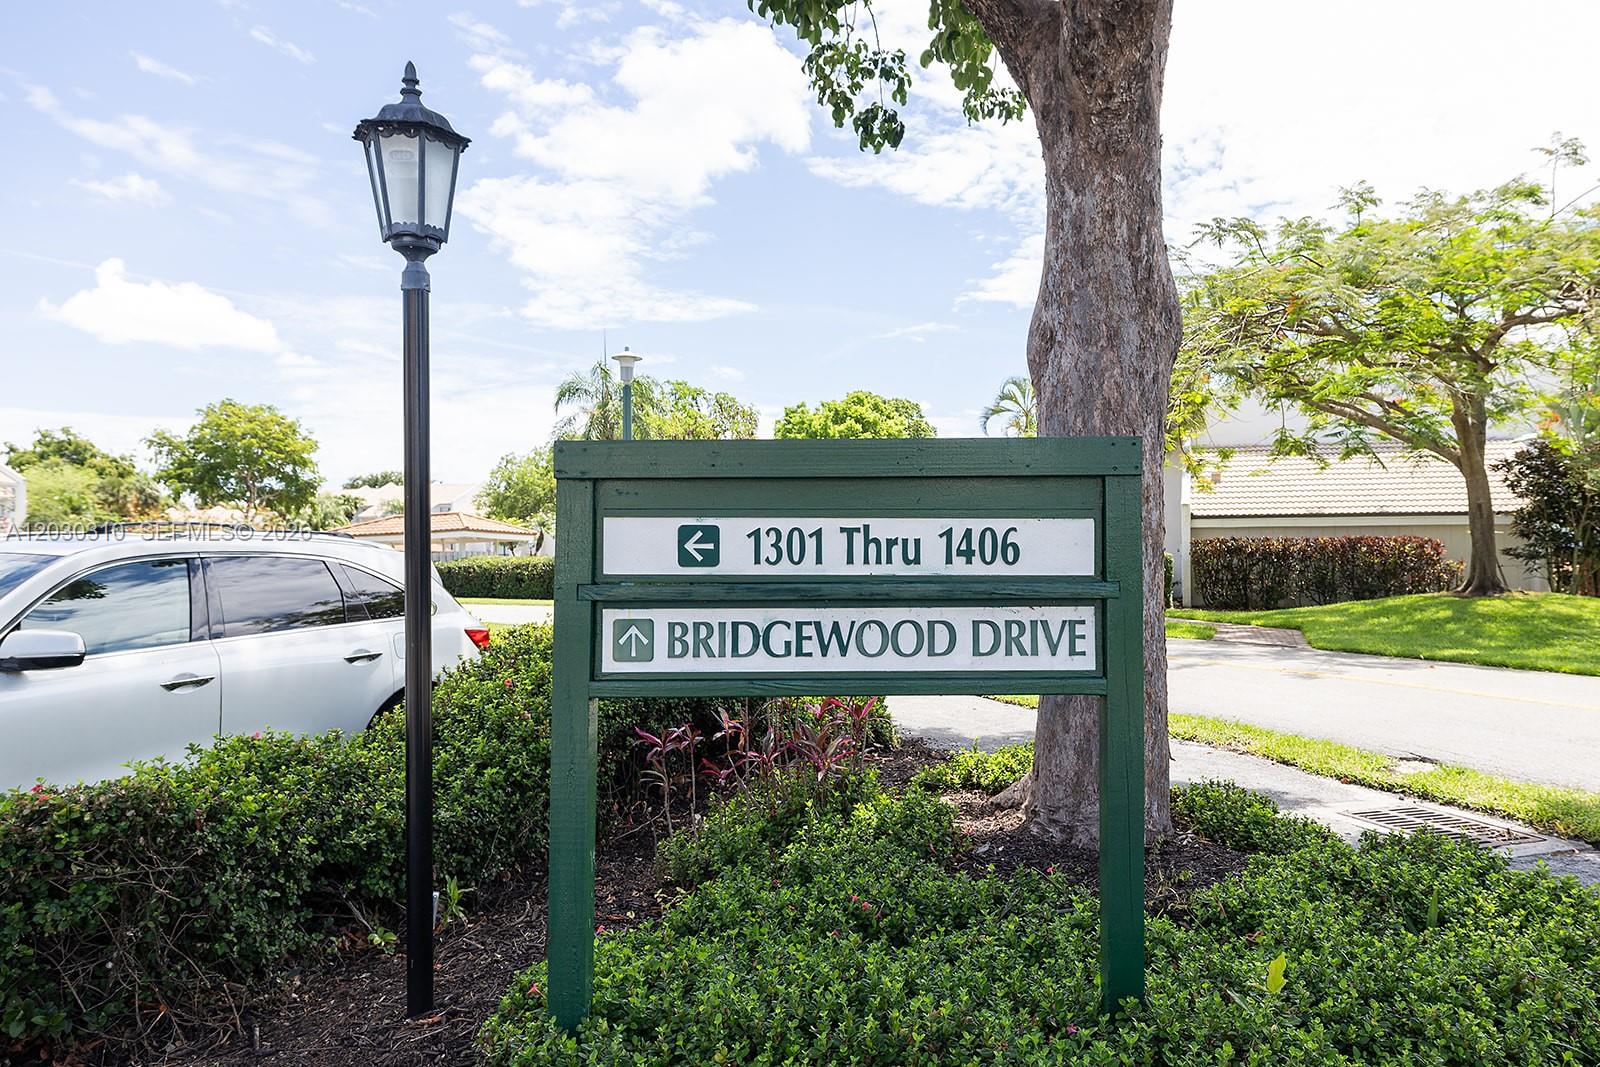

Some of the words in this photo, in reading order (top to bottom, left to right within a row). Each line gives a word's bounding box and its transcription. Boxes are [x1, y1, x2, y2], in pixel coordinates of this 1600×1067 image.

[745, 527, 823, 567] 1301
[839, 523, 922, 566] Thru
[937, 527, 1021, 567] 1406
[667, 619, 957, 659] BRIDGEWOOD
[971, 619, 1087, 657] DRIVE
